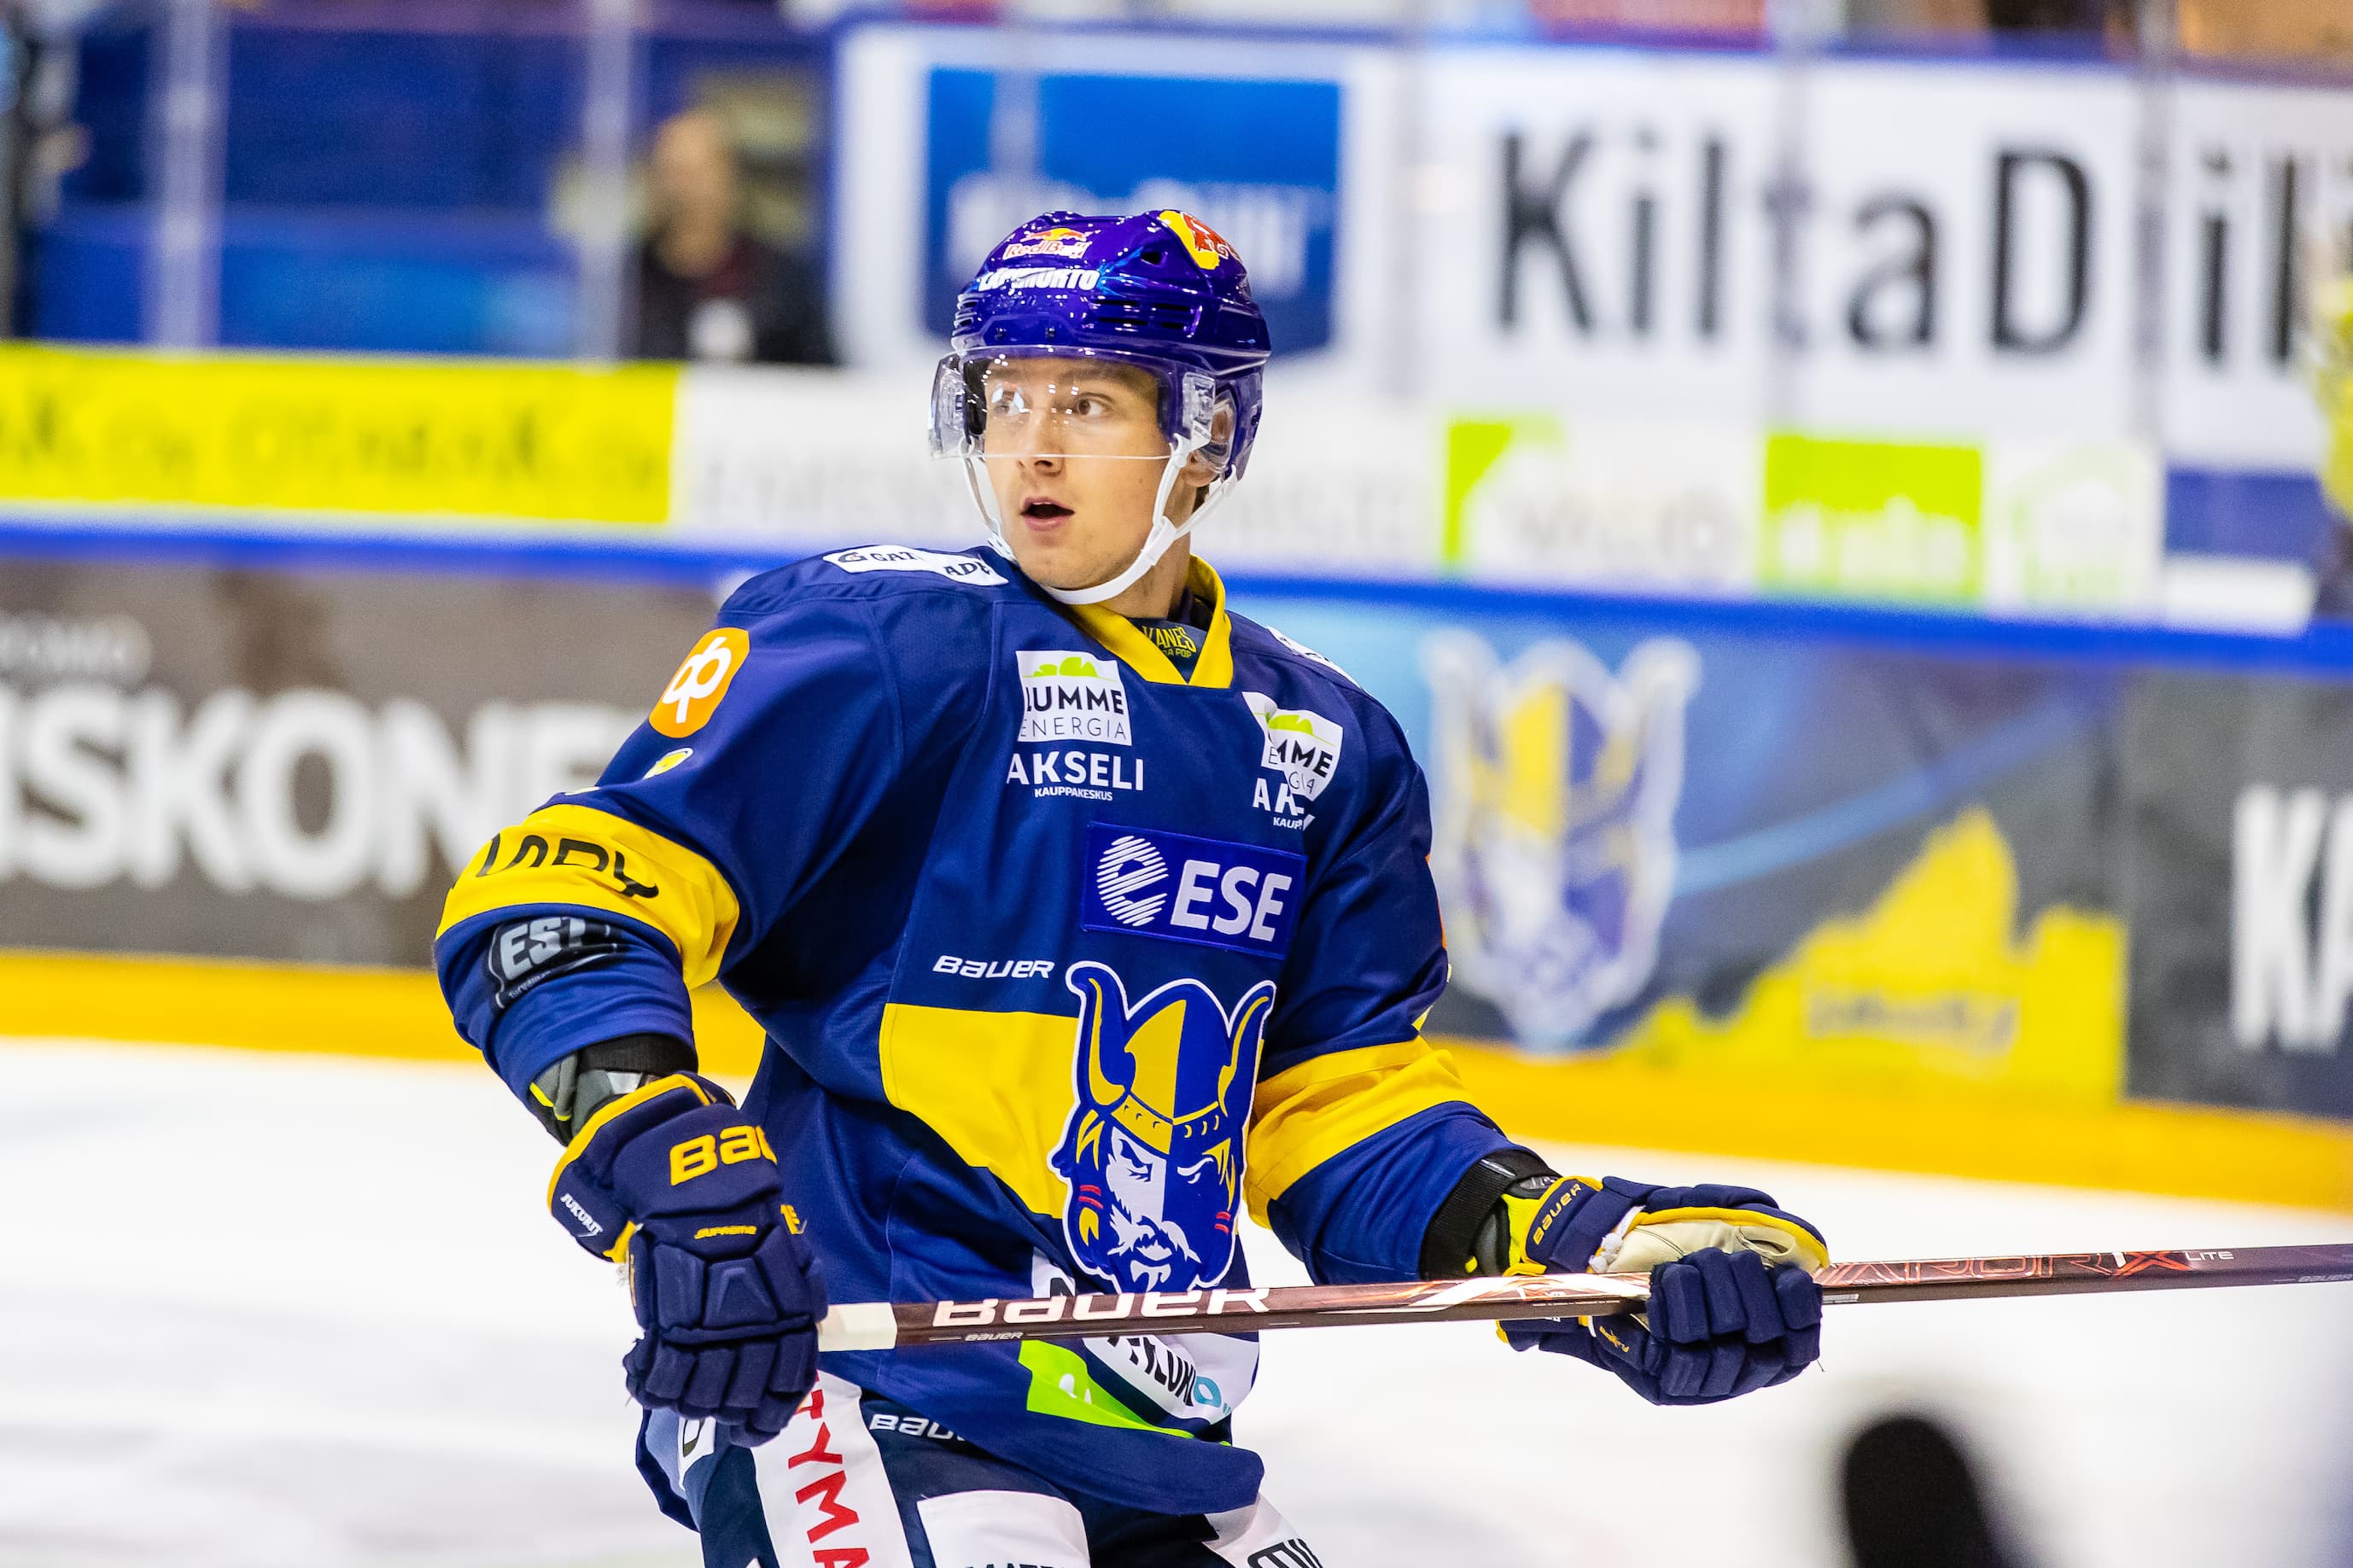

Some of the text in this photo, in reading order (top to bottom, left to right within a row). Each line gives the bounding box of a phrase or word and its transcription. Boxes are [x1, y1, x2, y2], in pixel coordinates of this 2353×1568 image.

[1006, 750, 1144, 791] AKSELI
[1034, 786, 1113, 801] KAUPPAKESKUS
[1170, 859, 1293, 942] ESE
[2186, 1250, 2234, 1262] LITE
